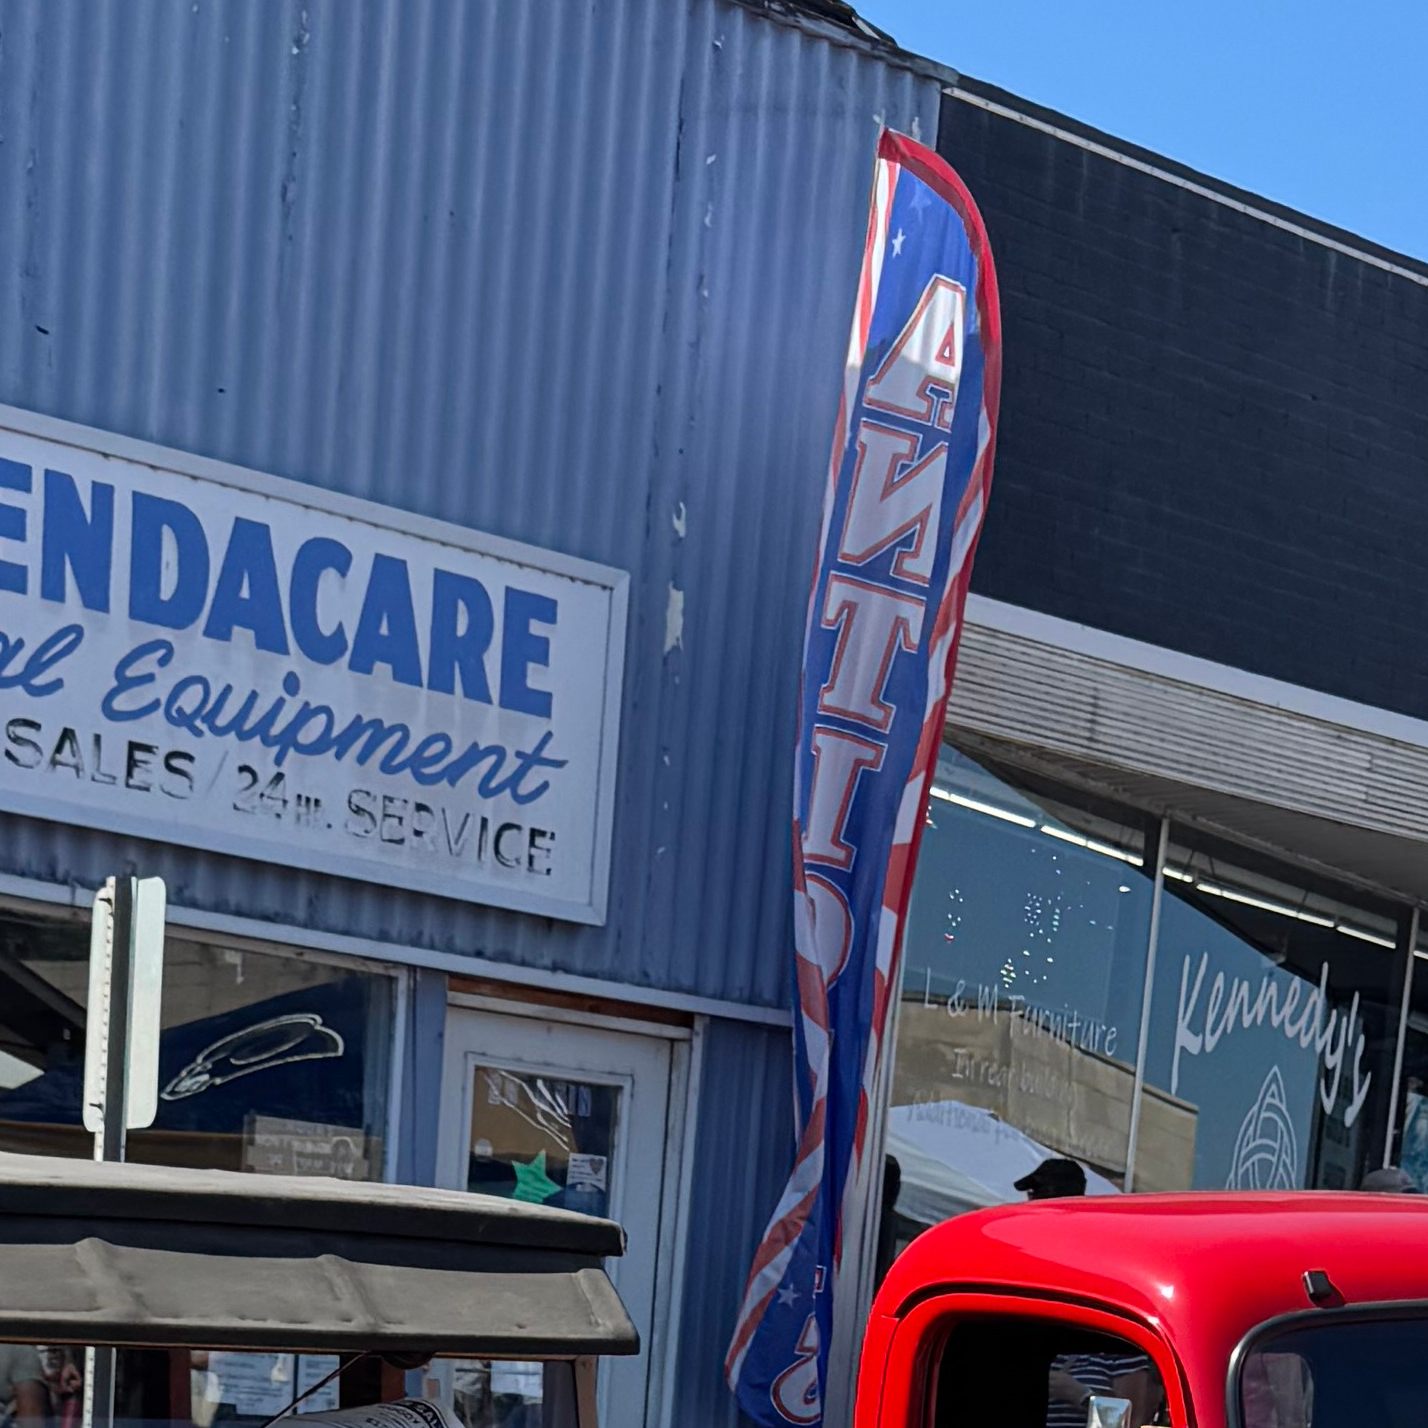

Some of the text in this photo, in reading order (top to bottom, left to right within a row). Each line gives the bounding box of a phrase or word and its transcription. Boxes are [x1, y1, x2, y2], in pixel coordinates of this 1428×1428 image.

[4, 717, 196, 802] SALES
[345, 788, 556, 877] SERVICE
[101, 641, 569, 805] Equipment
[924, 966, 1118, 1056] L & M Furniture
[1171, 951, 1371, 1128] Kennedy's
